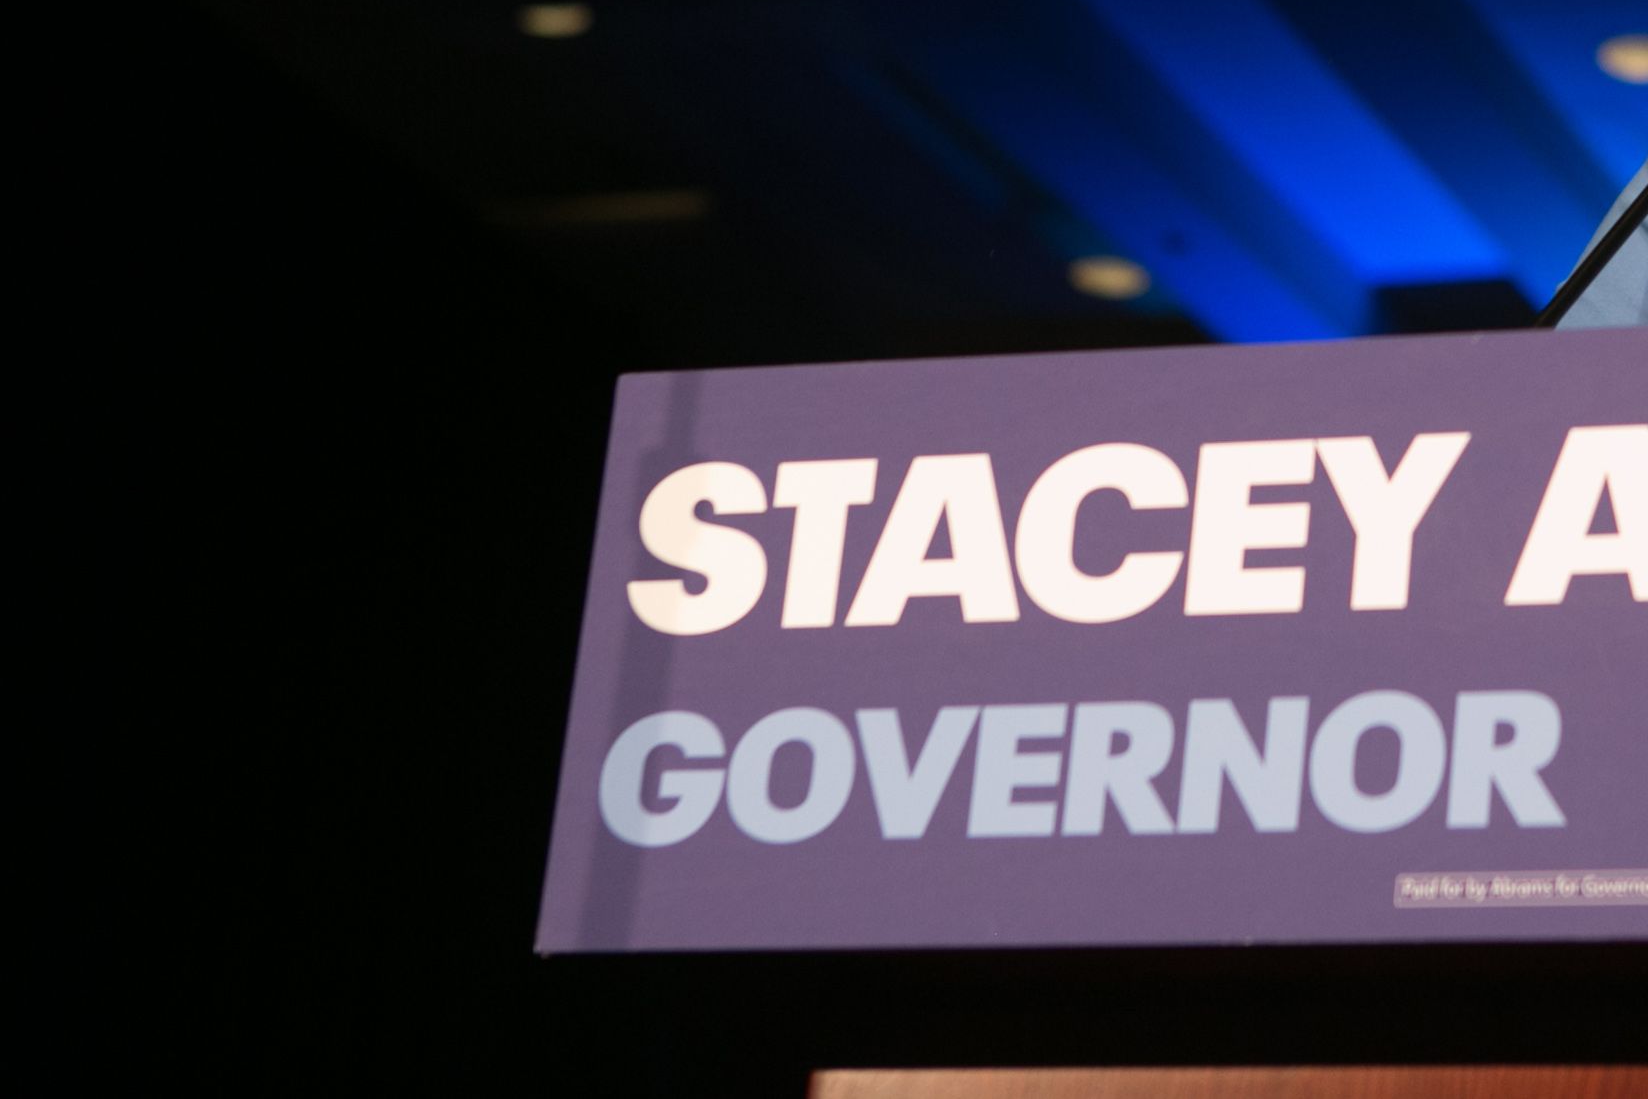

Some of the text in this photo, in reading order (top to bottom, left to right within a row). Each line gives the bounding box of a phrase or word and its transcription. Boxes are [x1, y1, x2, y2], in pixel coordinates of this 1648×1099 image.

[628, 433, 1471, 635] STACEY
[600, 690, 1566, 847] GOVERNOR
[1400, 876, 1439, 899] Paid
[1439, 875, 1464, 898] for
[1465, 875, 1486, 902] by
[1490, 874, 1553, 898] Abrams
[1555, 873, 1579, 898] for
